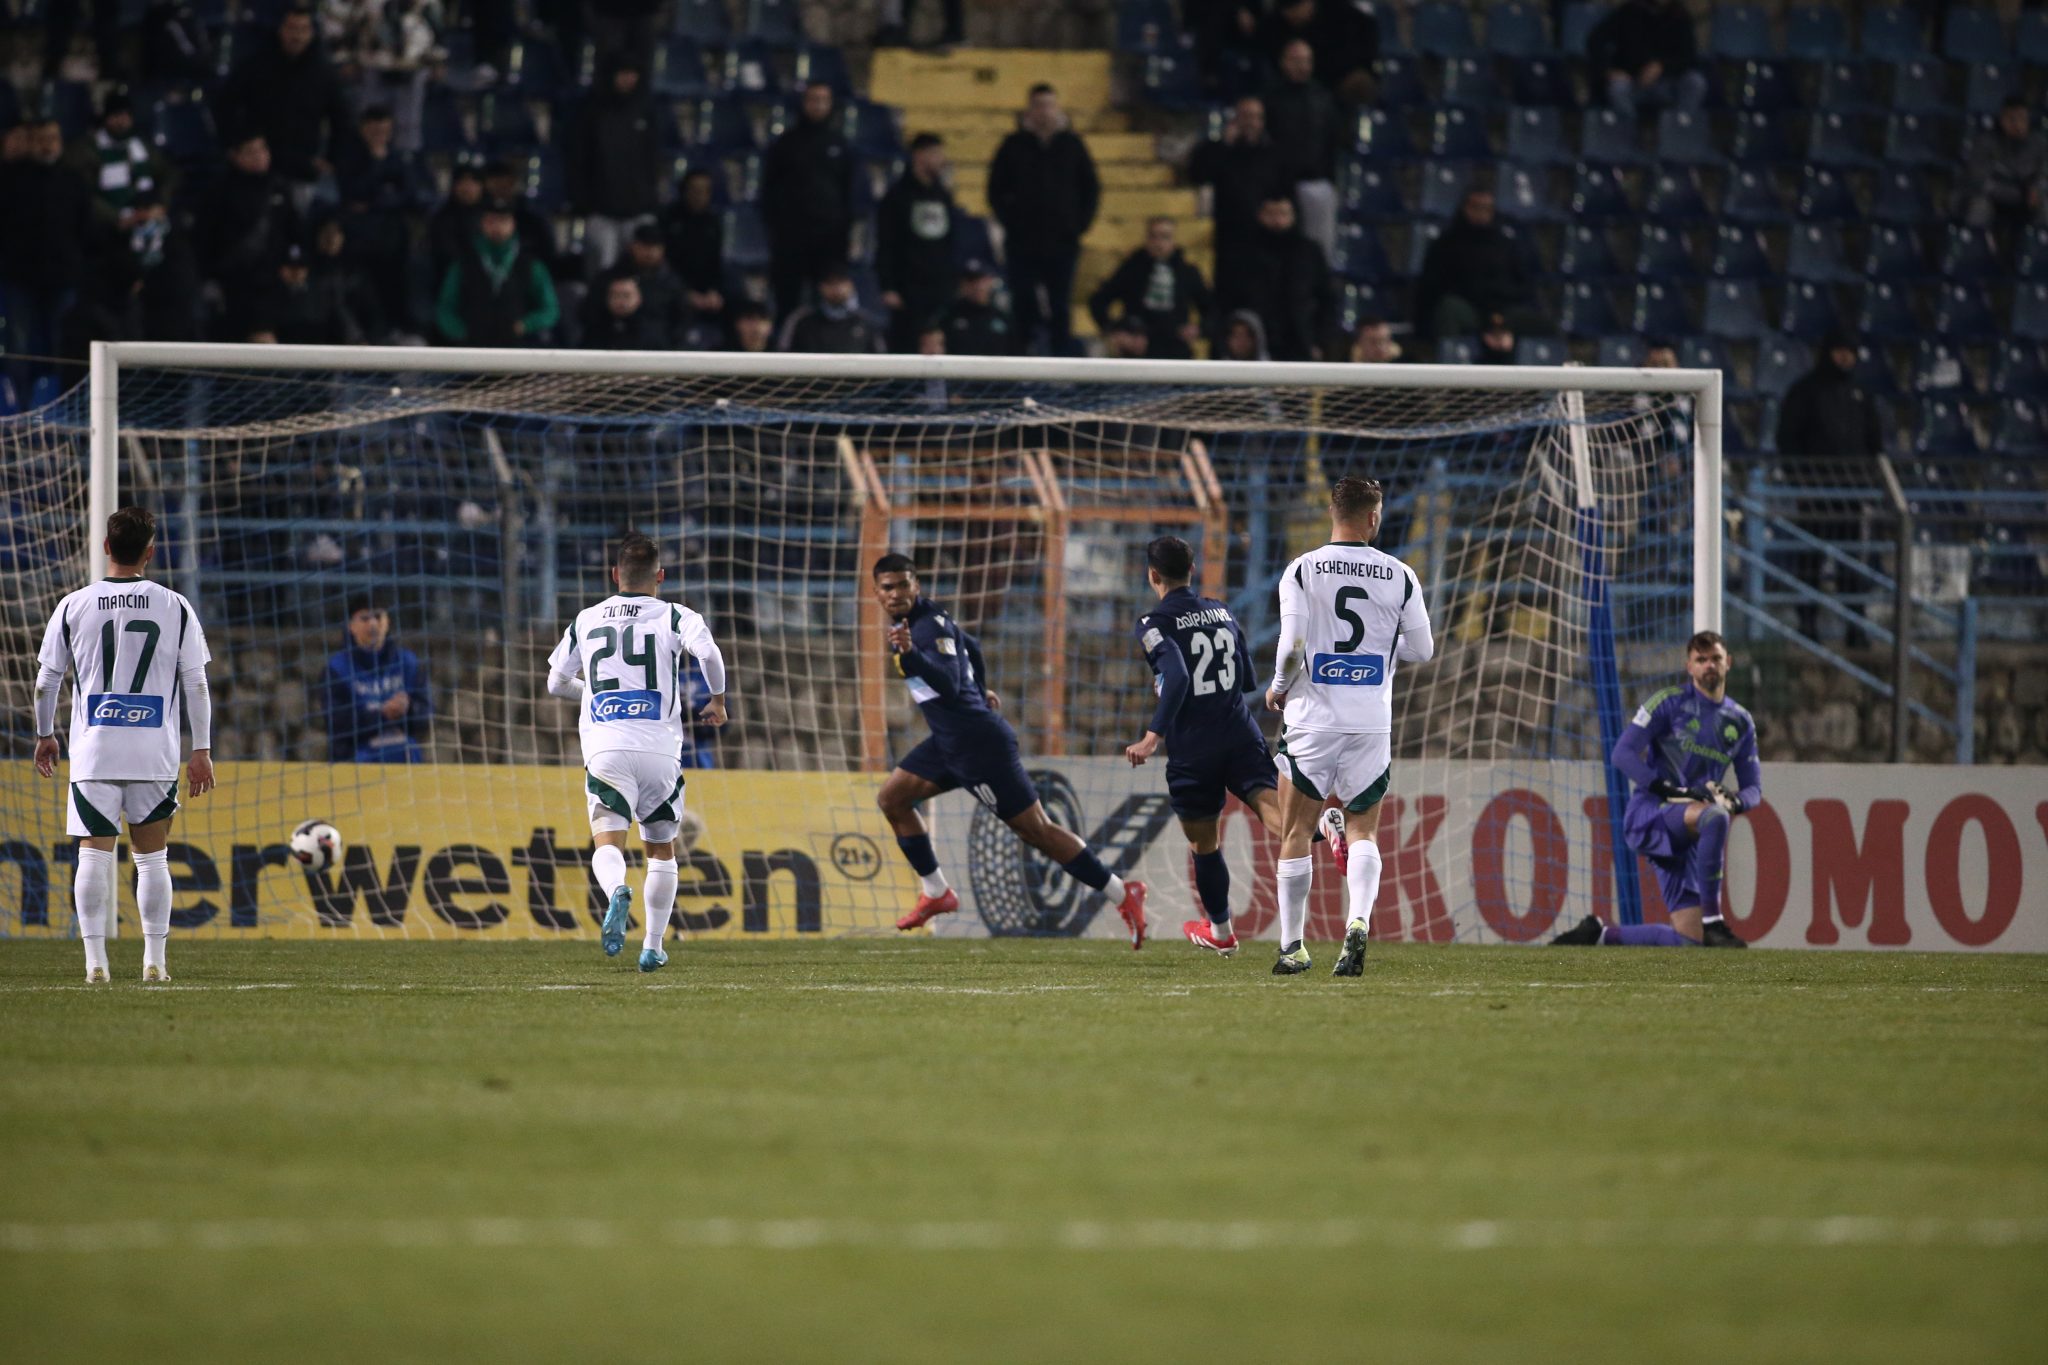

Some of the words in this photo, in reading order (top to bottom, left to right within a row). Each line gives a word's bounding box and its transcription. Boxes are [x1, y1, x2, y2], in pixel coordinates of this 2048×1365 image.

[1315, 560, 1393, 581] SCHENKEVELD
[98, 594, 149, 610] MANCINI
[1334, 585, 1369, 653] 5
[101, 619, 161, 694] 17
[587, 624, 658, 695] 24
[1190, 627, 1236, 697] 23
[973, 783, 997, 806] 10
[838, 847, 873, 865] 21+
